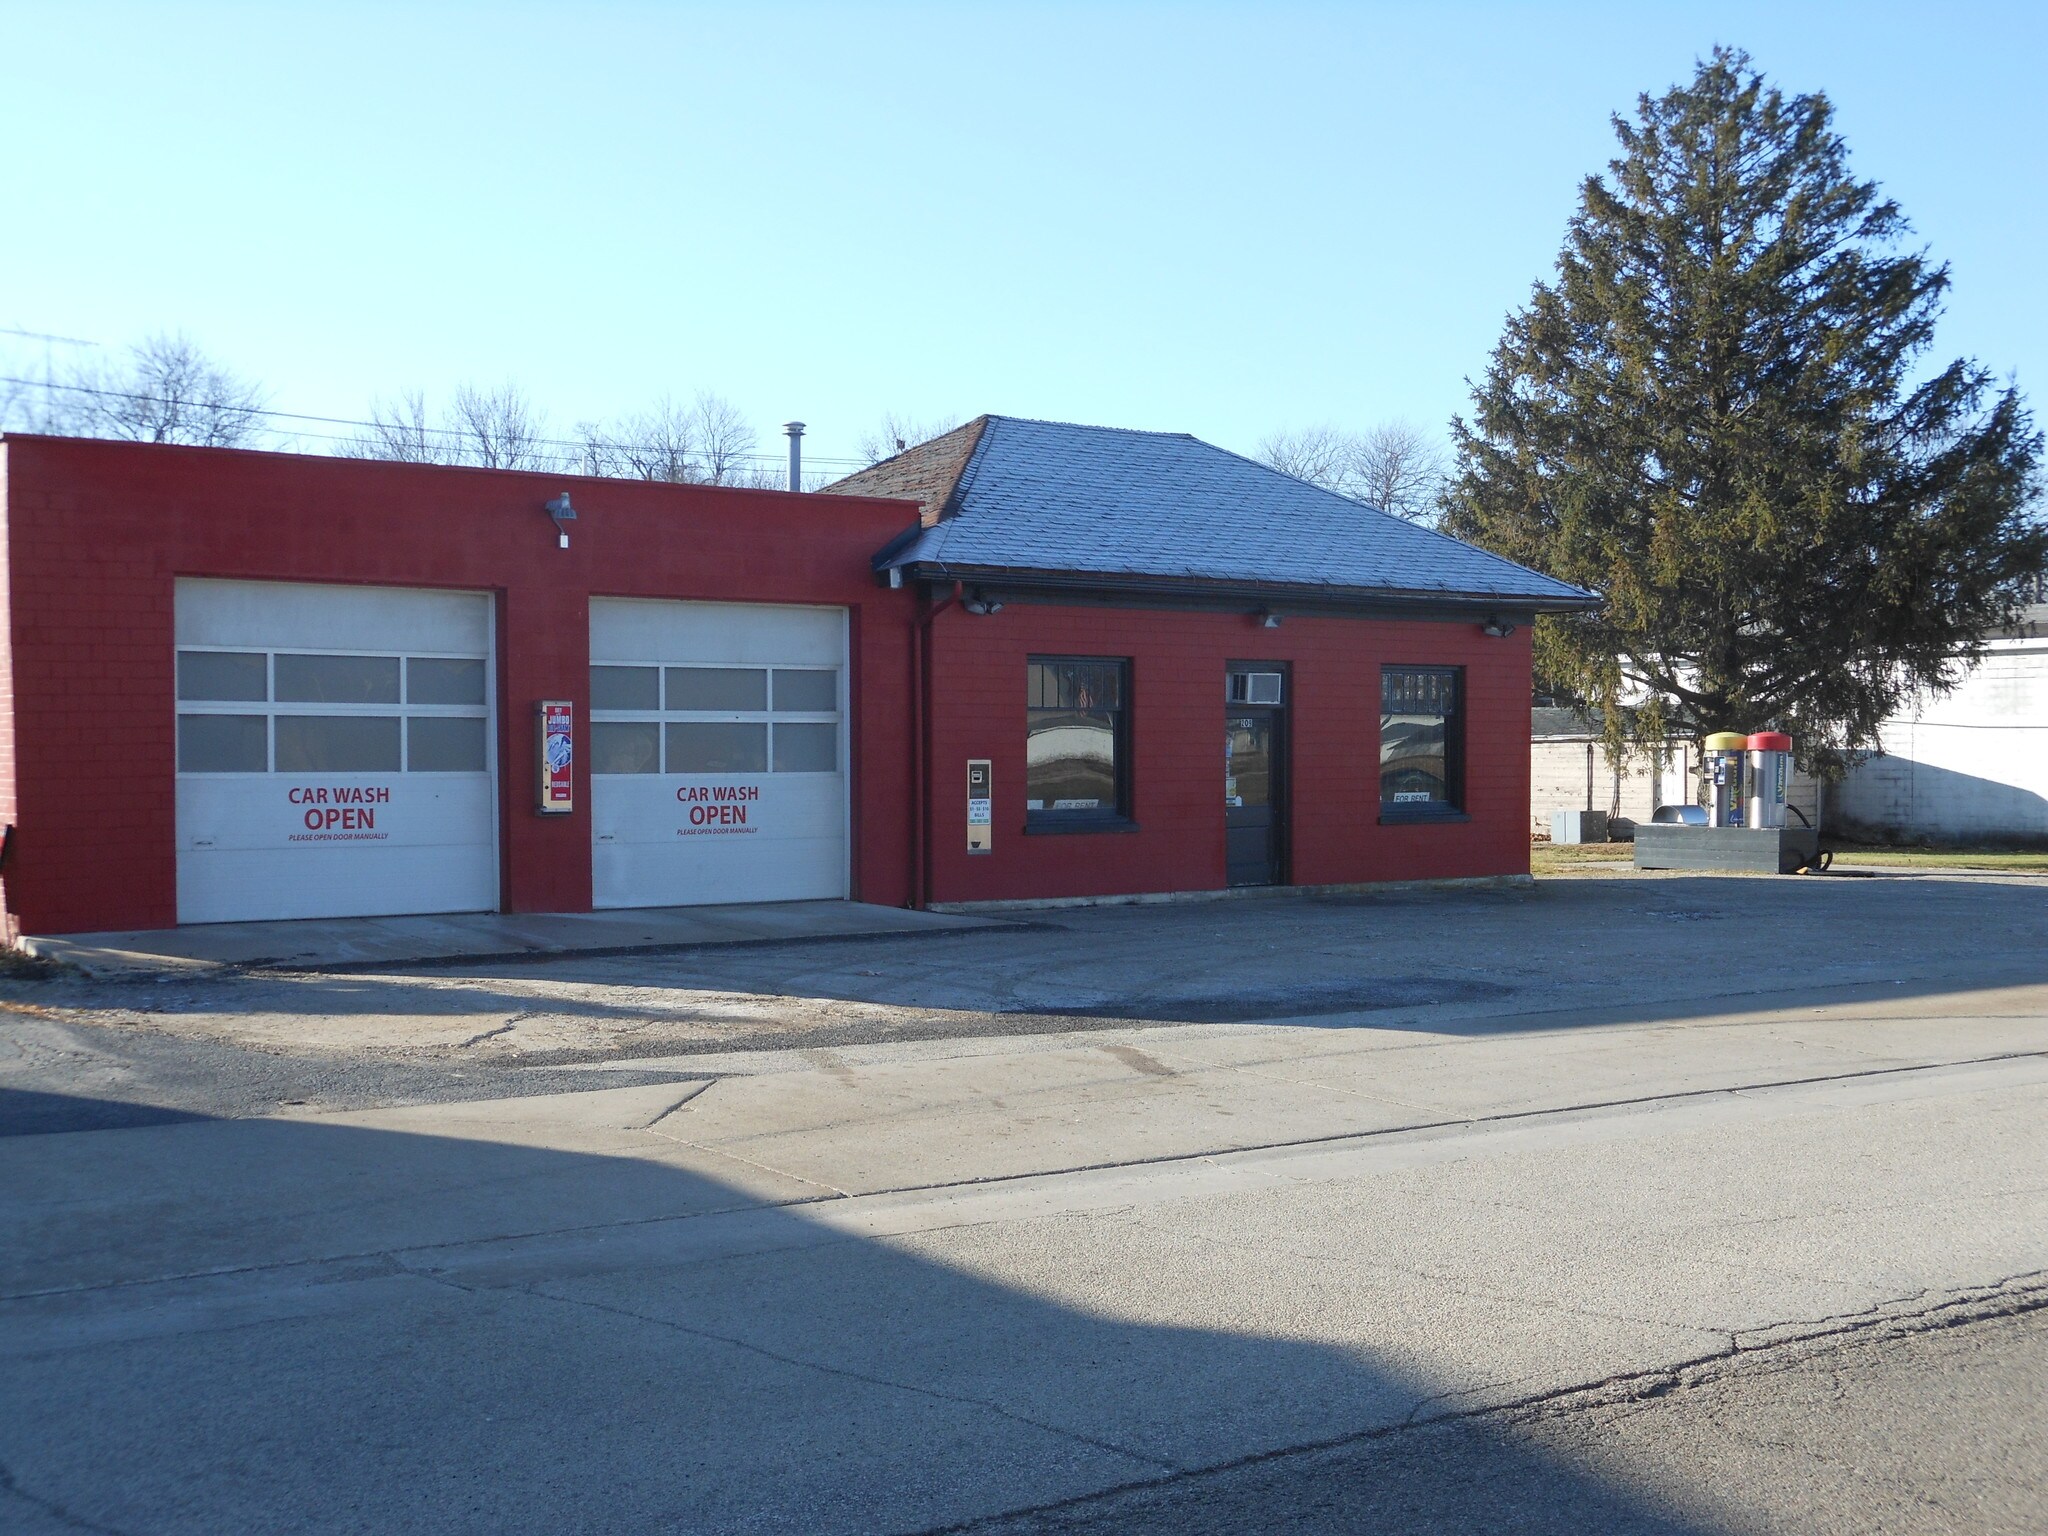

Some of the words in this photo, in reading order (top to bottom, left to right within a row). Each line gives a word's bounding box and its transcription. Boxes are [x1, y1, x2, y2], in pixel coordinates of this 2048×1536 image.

[548, 715, 570, 725] JUMBO
[288, 788, 328, 804] CAR
[333, 787, 389, 803] WASH
[677, 787, 709, 802] CAR
[713, 786, 758, 801] WASH
[304, 808, 374, 830] OPEN
[689, 805, 746, 825] OPEN
